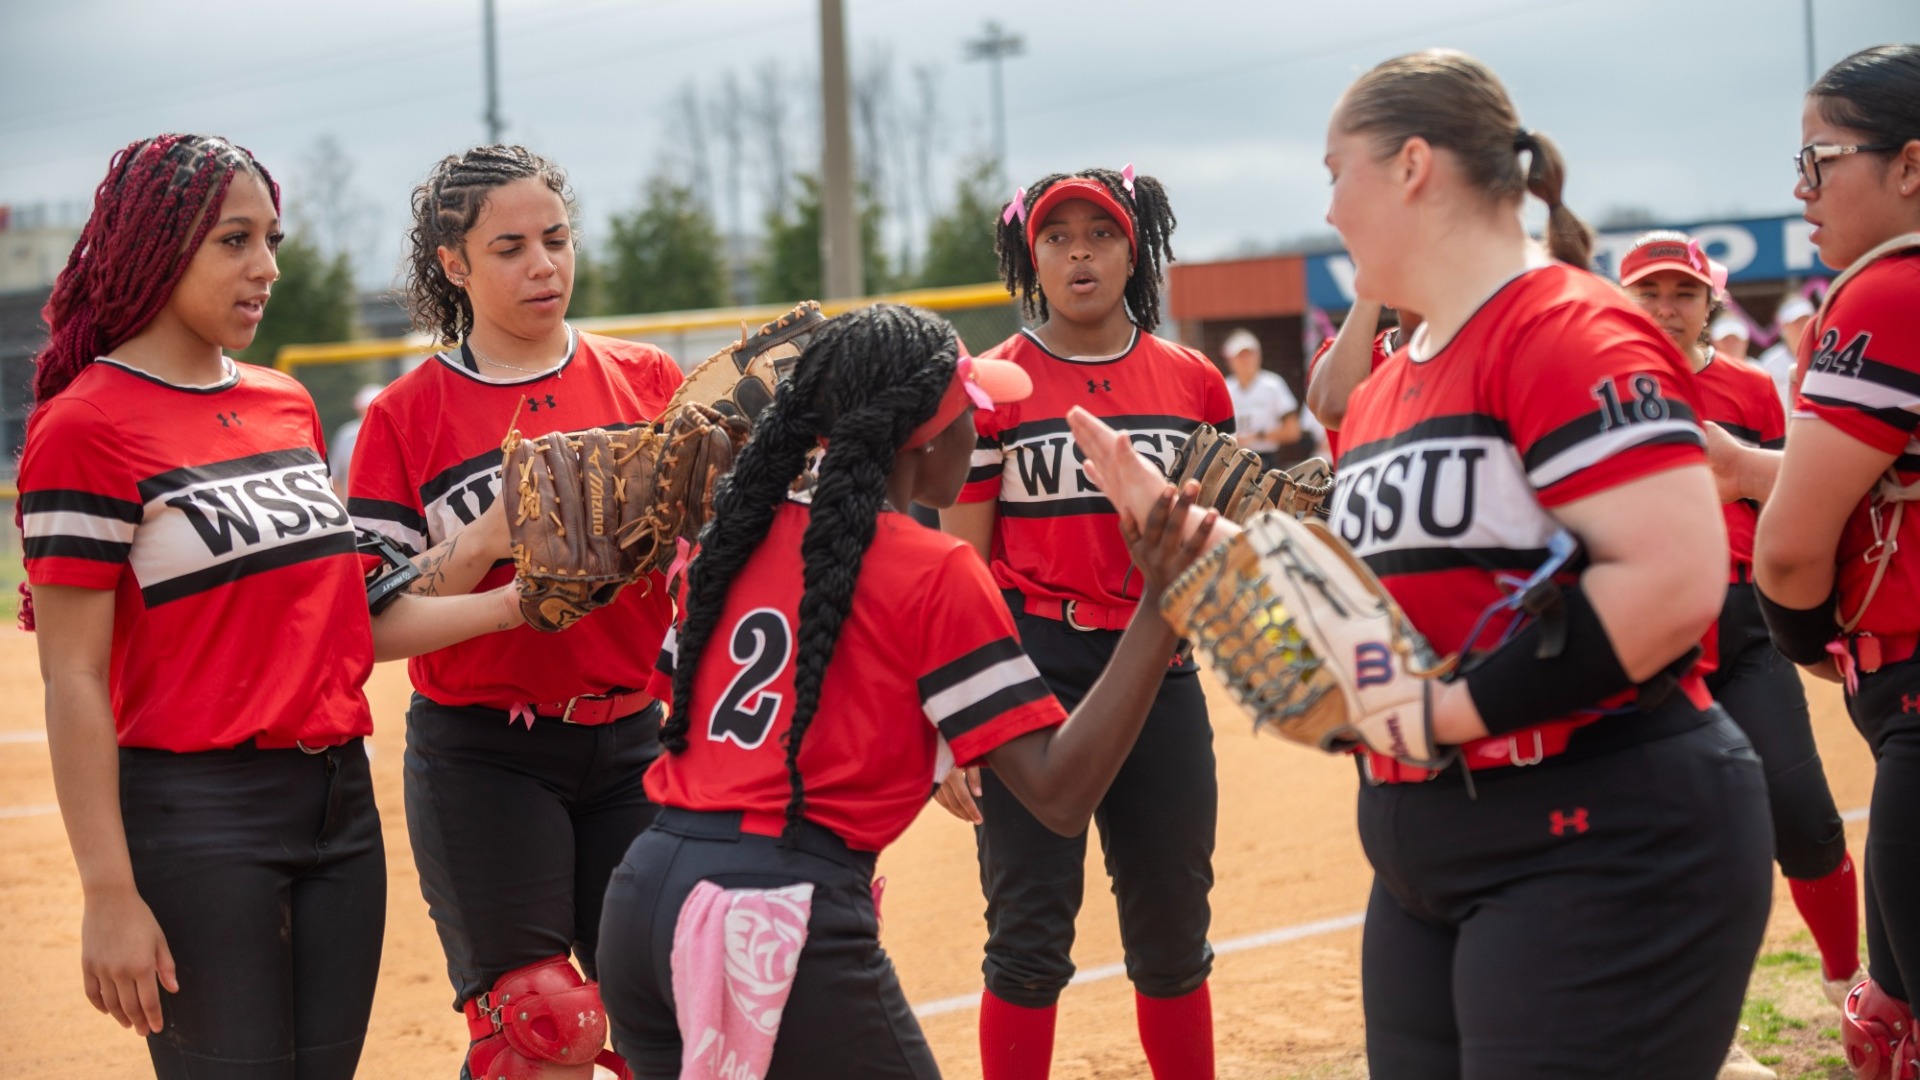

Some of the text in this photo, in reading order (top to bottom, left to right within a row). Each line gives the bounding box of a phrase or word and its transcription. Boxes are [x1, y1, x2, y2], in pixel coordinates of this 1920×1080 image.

[1812, 327, 1872, 378] 24
[1591, 373, 1669, 432] 18
[164, 468, 350, 558] WSS
[588, 471, 605, 537] MIZUNO
[707, 606, 793, 750] 2
